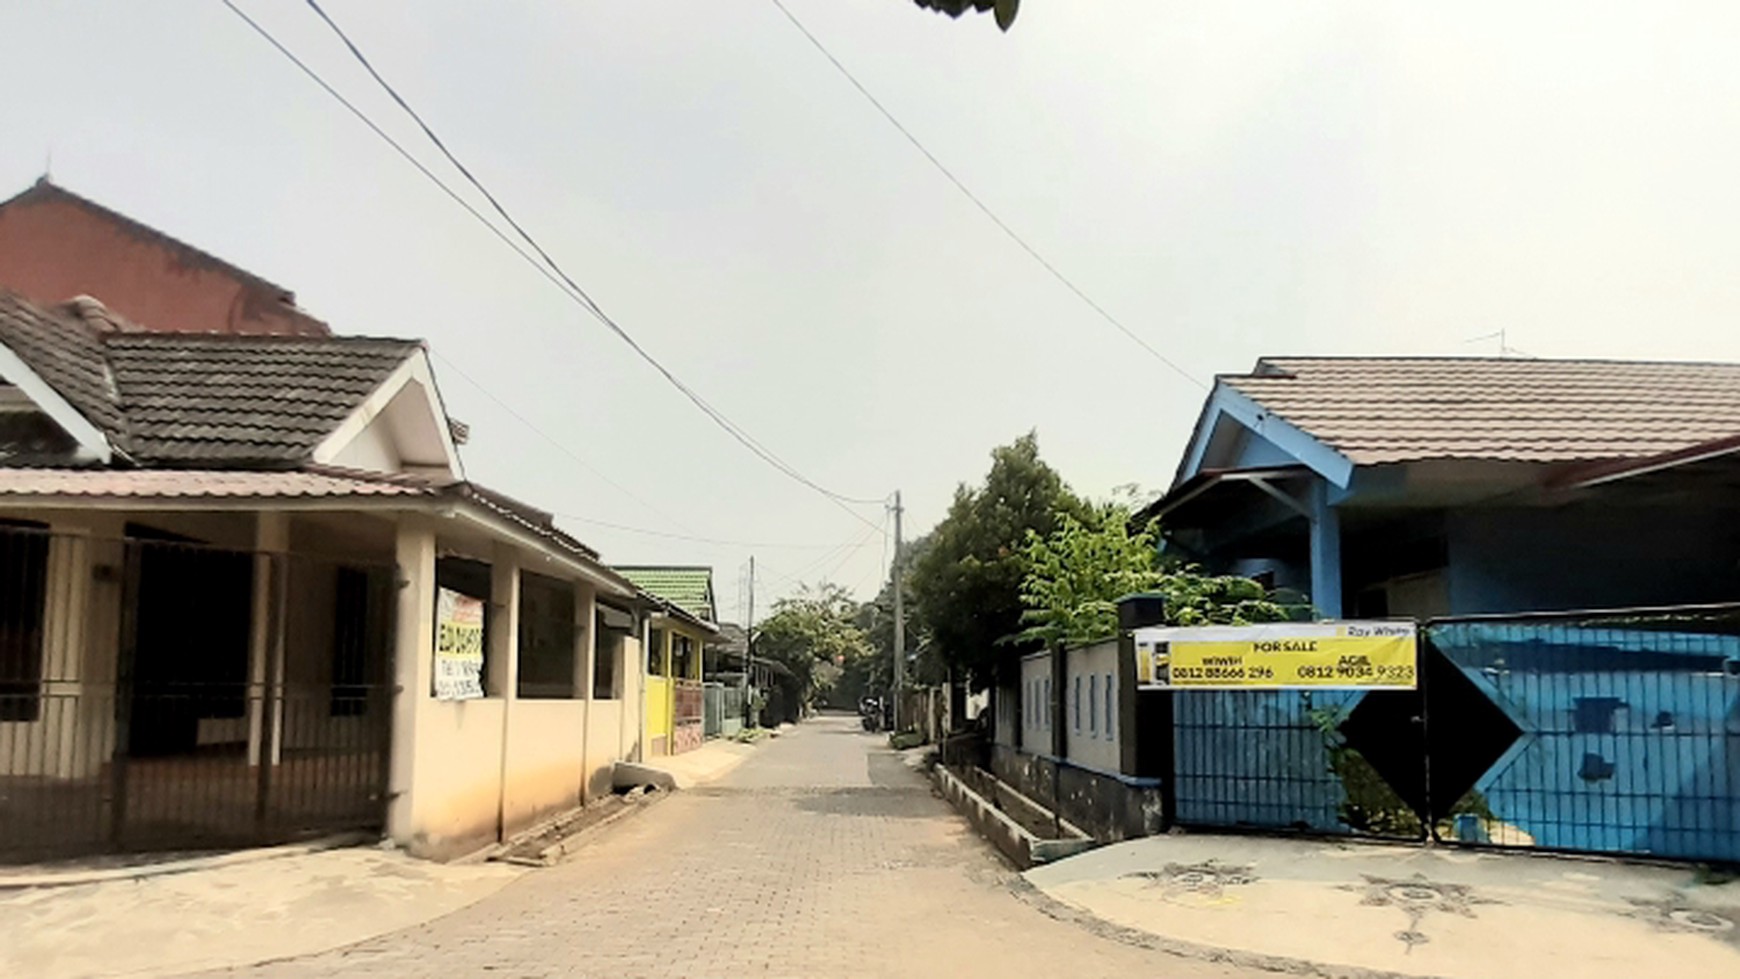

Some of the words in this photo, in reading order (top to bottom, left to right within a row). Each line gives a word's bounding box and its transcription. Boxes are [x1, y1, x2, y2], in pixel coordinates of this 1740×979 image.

[1348, 626, 1371, 638] Ray
[1253, 641, 1281, 652] FOR
[1283, 641, 1318, 652] SALE
[1173, 667, 1203, 679] 0812
[1297, 665, 1333, 678] 0812
[1336, 665, 1374, 678] 9034
[1377, 664, 1415, 679] 9323
